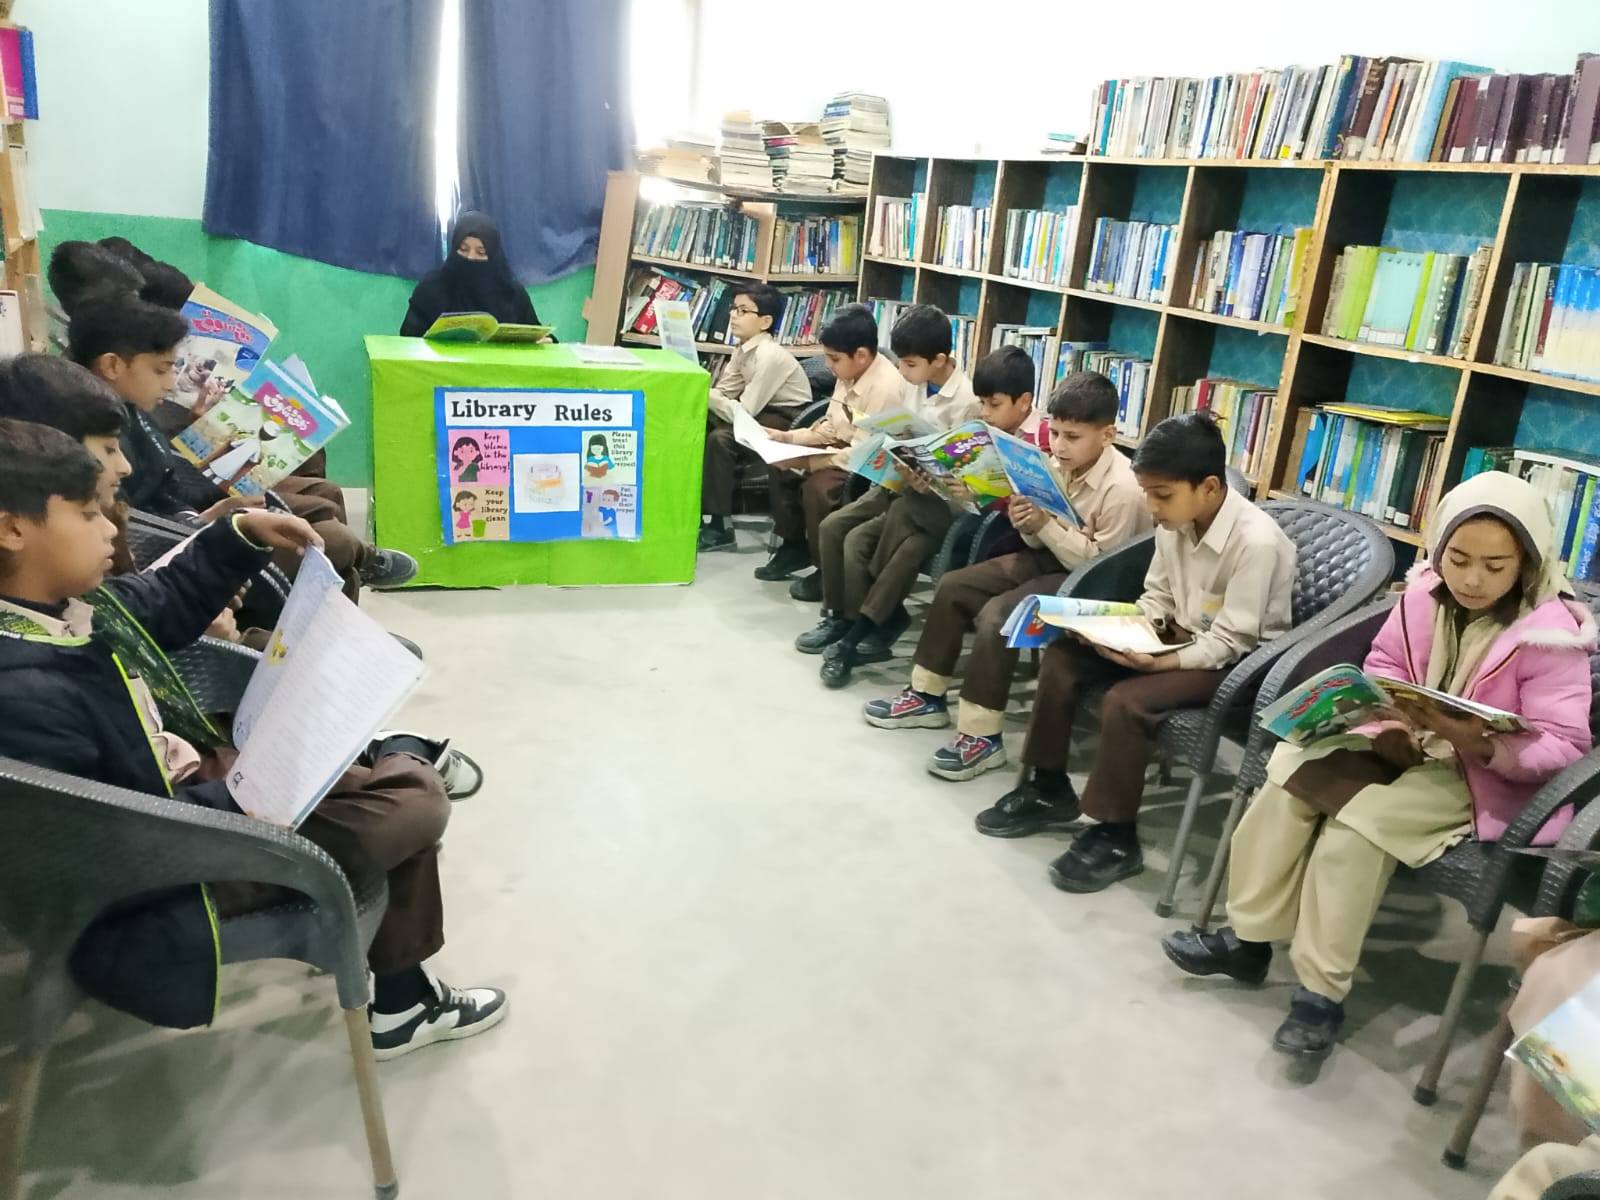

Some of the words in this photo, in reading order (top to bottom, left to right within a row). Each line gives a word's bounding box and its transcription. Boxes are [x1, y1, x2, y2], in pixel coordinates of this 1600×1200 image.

[451, 399, 537, 421] Library
[555, 404, 613, 422] Rules
[484, 431, 499, 442] Keep
[494, 450, 507, 458] the
[485, 489, 504, 497] Keep
[481, 506, 508, 514] library
